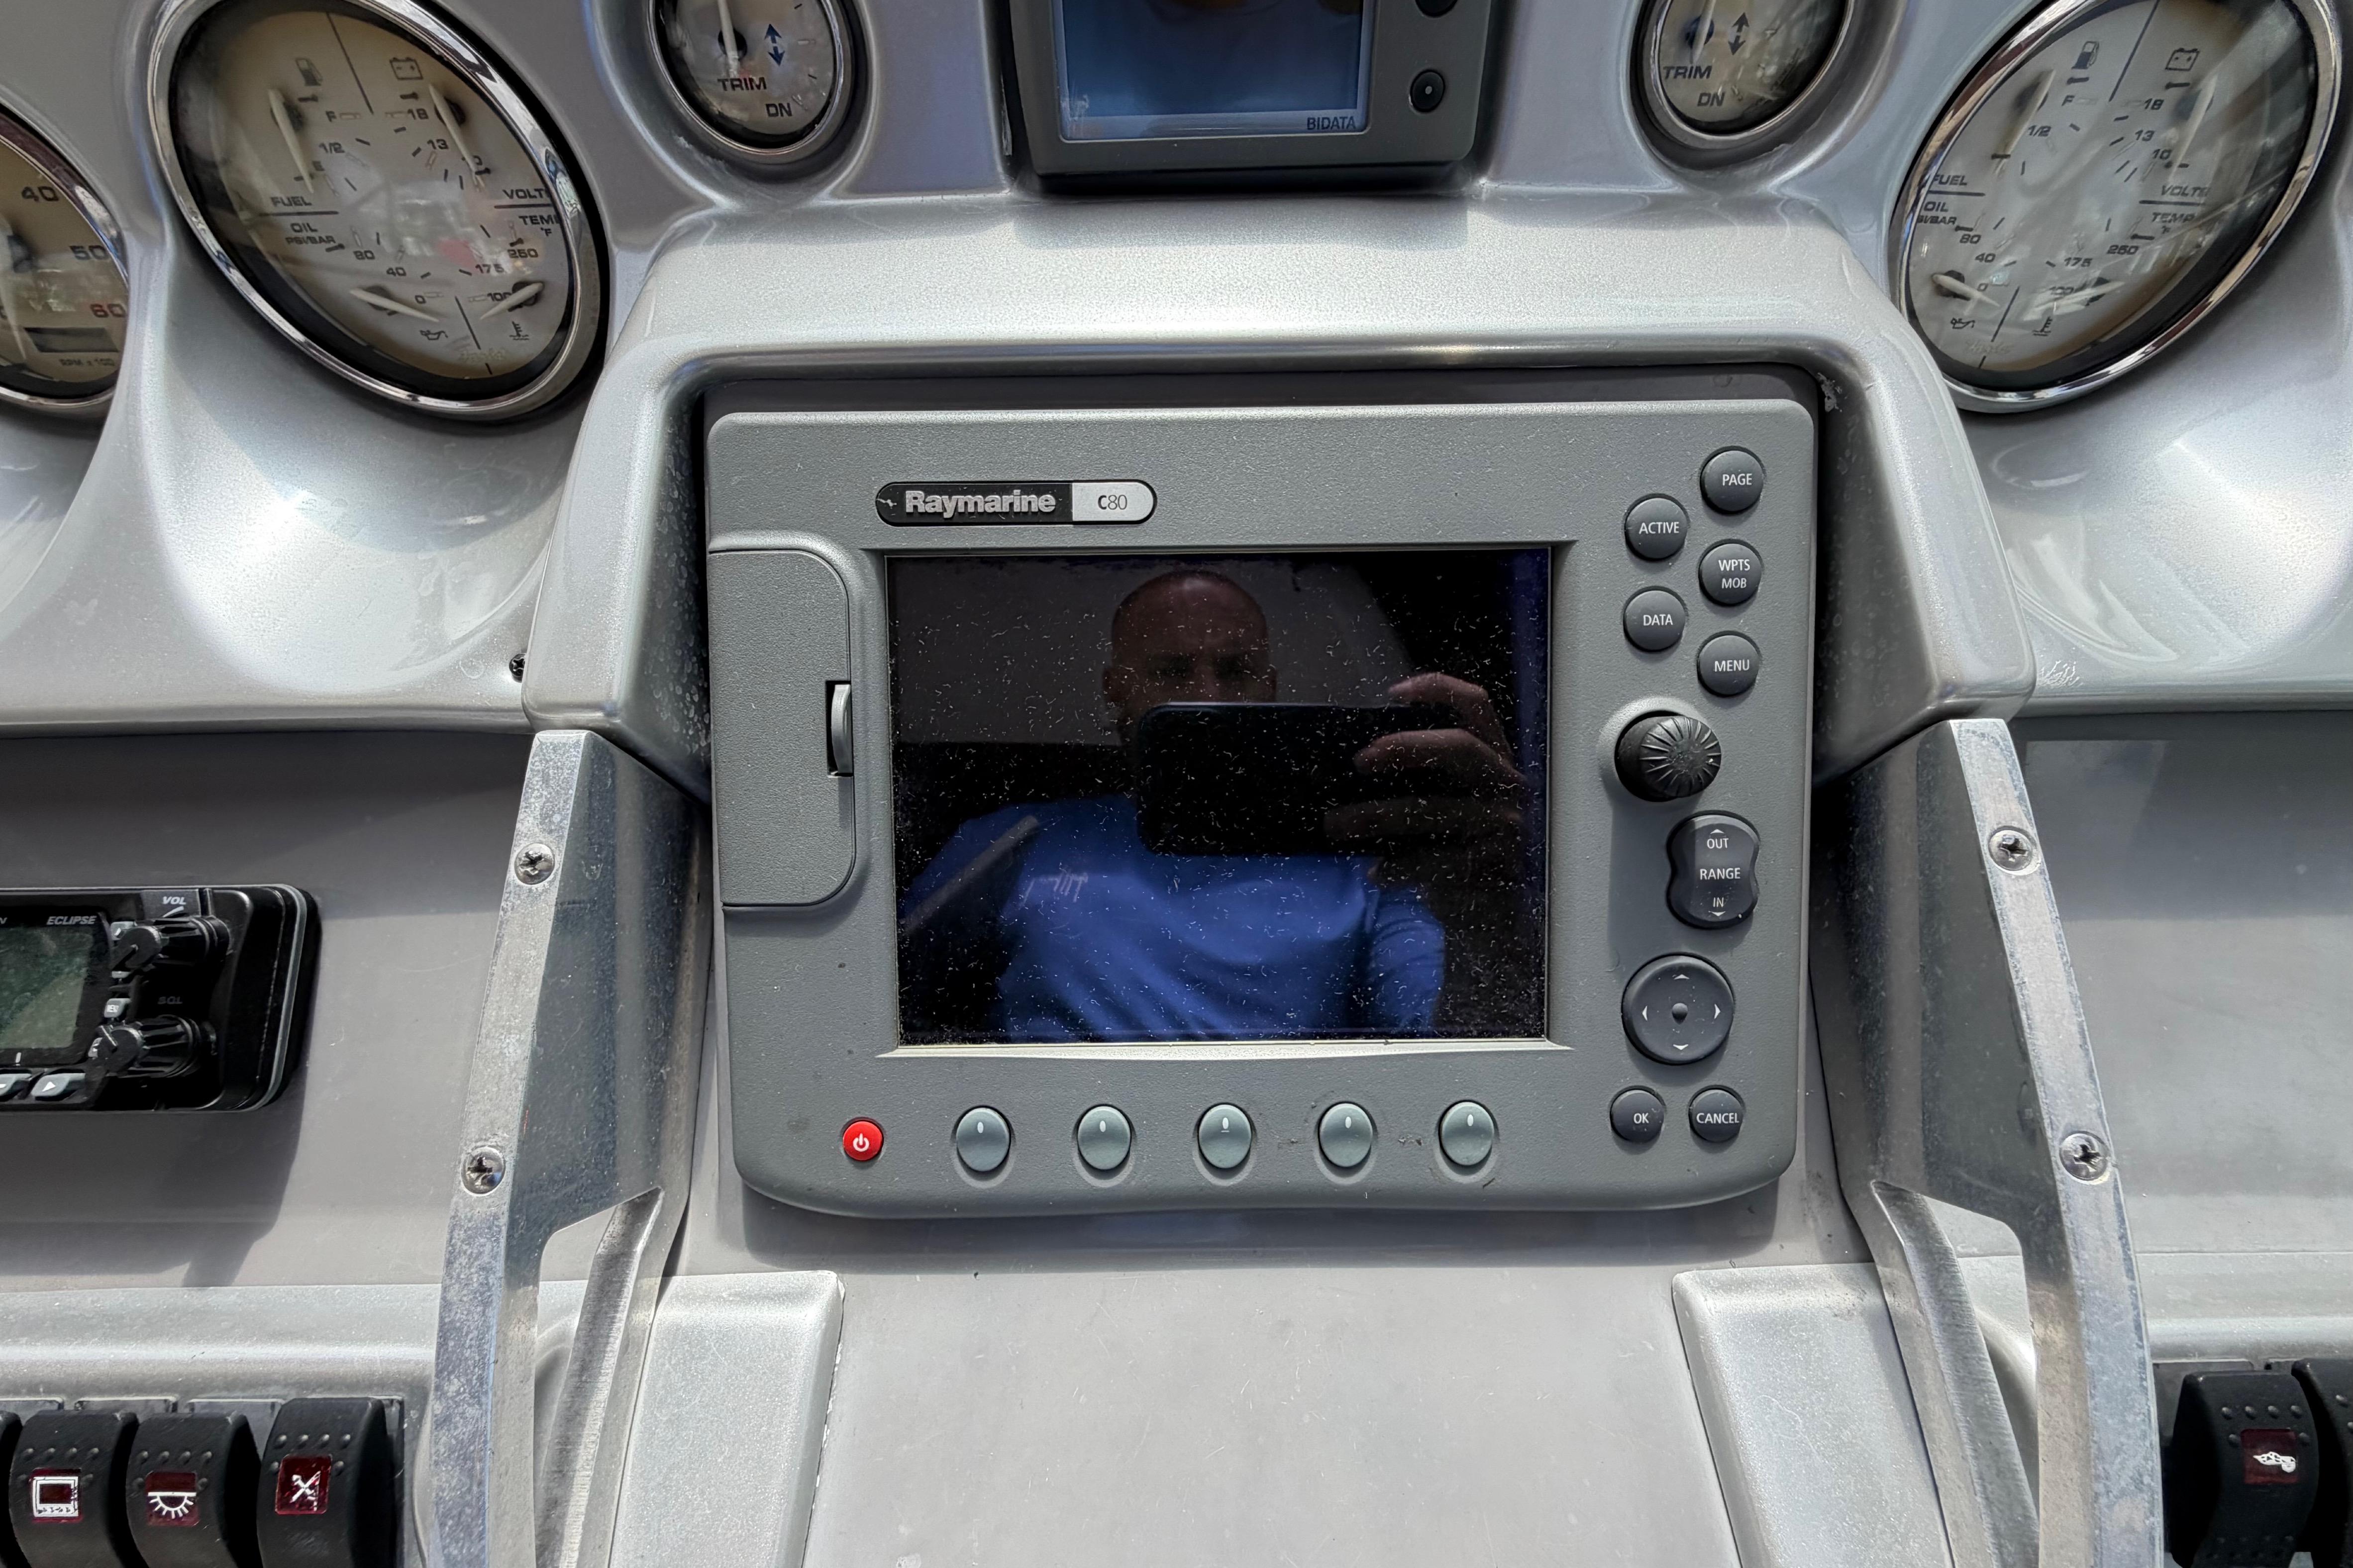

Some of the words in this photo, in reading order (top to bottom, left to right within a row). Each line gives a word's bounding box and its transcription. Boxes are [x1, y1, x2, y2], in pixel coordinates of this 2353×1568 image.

[1663, 65, 1712, 80] TRIM
[717, 77, 767, 92] TRIM
[1697, 93, 1725, 106] DN
[2061, 95, 2075, 106] F
[2144, 98, 2164, 110] 18
[407, 108, 429, 120] 18
[765, 102, 792, 117] DN
[326, 111, 337, 122] F
[1307, 116, 1356, 130] BIDATA
[2028, 125, 2051, 137] 1/2
[2135, 130, 2155, 141] 13
[319, 142, 345, 154] 1/2
[427, 139, 449, 150] 13
[2152, 149, 2172, 160] 10
[1933, 175, 1967, 186] FUEL
[21, 186, 59, 201] 40
[271, 196, 312, 206] FUEL
[1924, 201, 1948, 212] OIL
[1917, 215, 1957, 225] SI/BAR
[2152, 212, 2195, 223] TEMP
[290, 223, 318, 233] OIL
[1959, 234, 1981, 244] 80
[70, 245, 108, 260] 50
[353, 250, 375, 260] 80
[1975, 253, 1996, 263] 40
[2064, 257, 2092, 267] 175
[386, 267, 407, 277] 40
[475, 264, 504, 274] 175
[414, 294, 426, 304] 0
[90, 303, 126, 318] 60
[1722, 473, 1752, 486] PAGE
[905, 490, 1056, 518] Raymarine
[1639, 521, 1679, 534] ACTIVE
[1718, 558, 1750, 572] WPTS
[1722, 578, 1747, 589] MOB
[1643, 614, 1673, 626] DATA
[1715, 659, 1749, 672] MENU
[1707, 838, 1729, 849] OUT
[1700, 868, 1740, 880] RANGE
[163, 896, 187, 905] VOL
[1713, 897, 1724, 908] IN
[46, 915, 98, 926] ECLIPSE
[1634, 1112, 1649, 1124] OK
[1696, 1112, 1739, 1124] CANCEL
